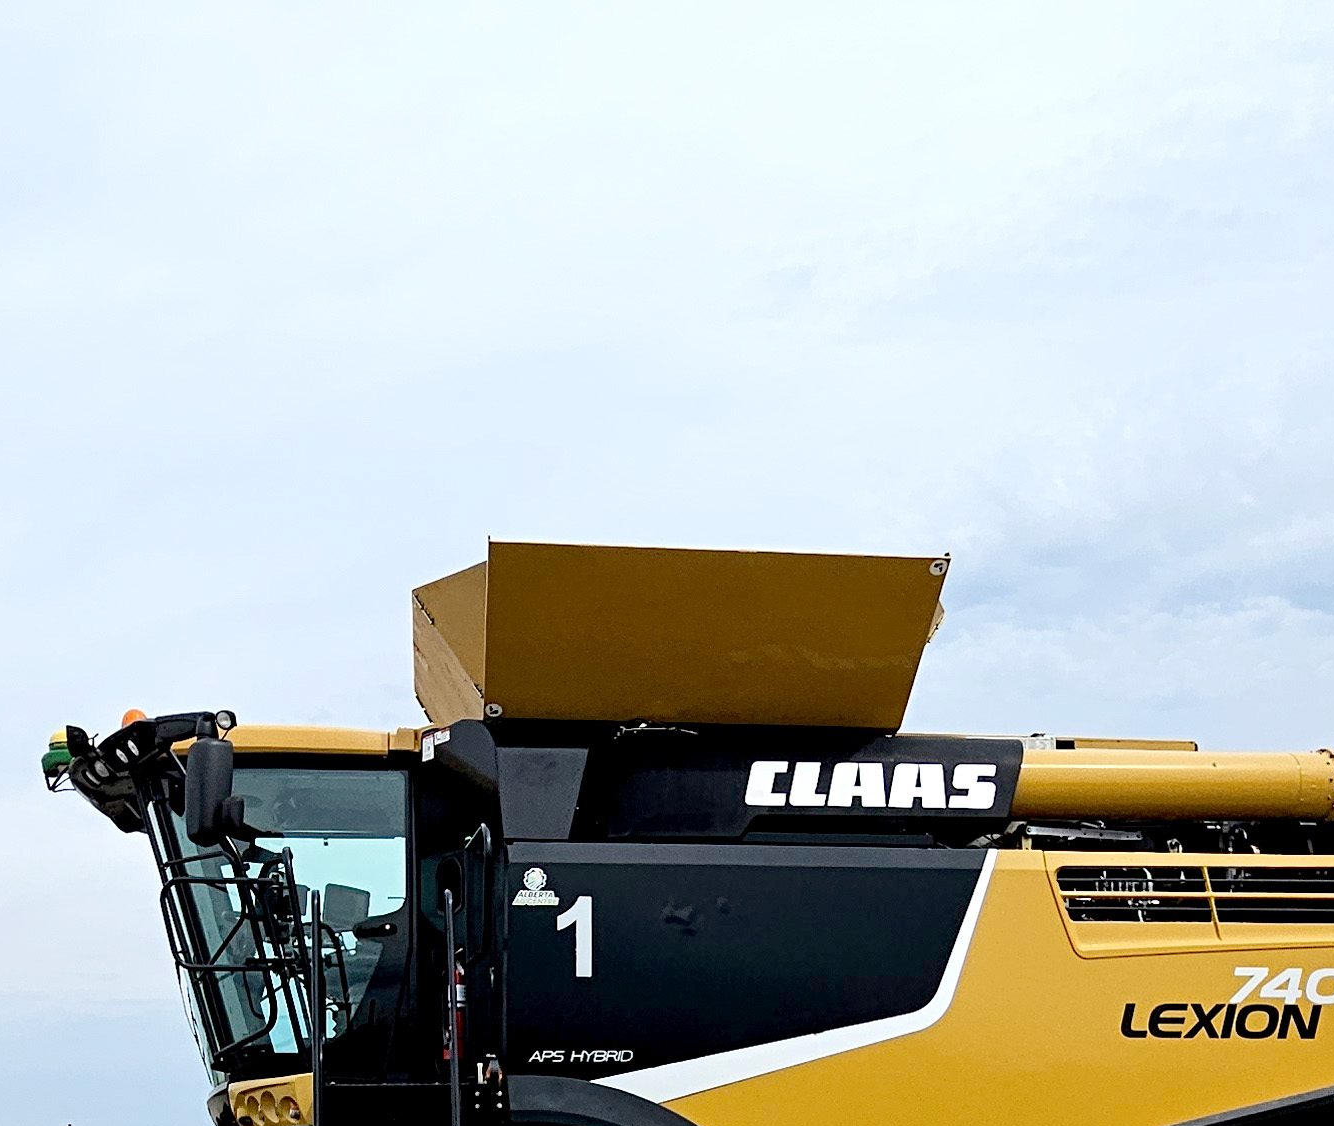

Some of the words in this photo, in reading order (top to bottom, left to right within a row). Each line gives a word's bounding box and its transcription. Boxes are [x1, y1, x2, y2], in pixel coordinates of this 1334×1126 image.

[744, 760, 997, 809] CLAAS
[556, 895, 593, 978] 1
[1120, 1002, 1323, 1040] LEXION
[528, 1050, 566, 1063] APS
[570, 1050, 634, 1063] HYBRID
